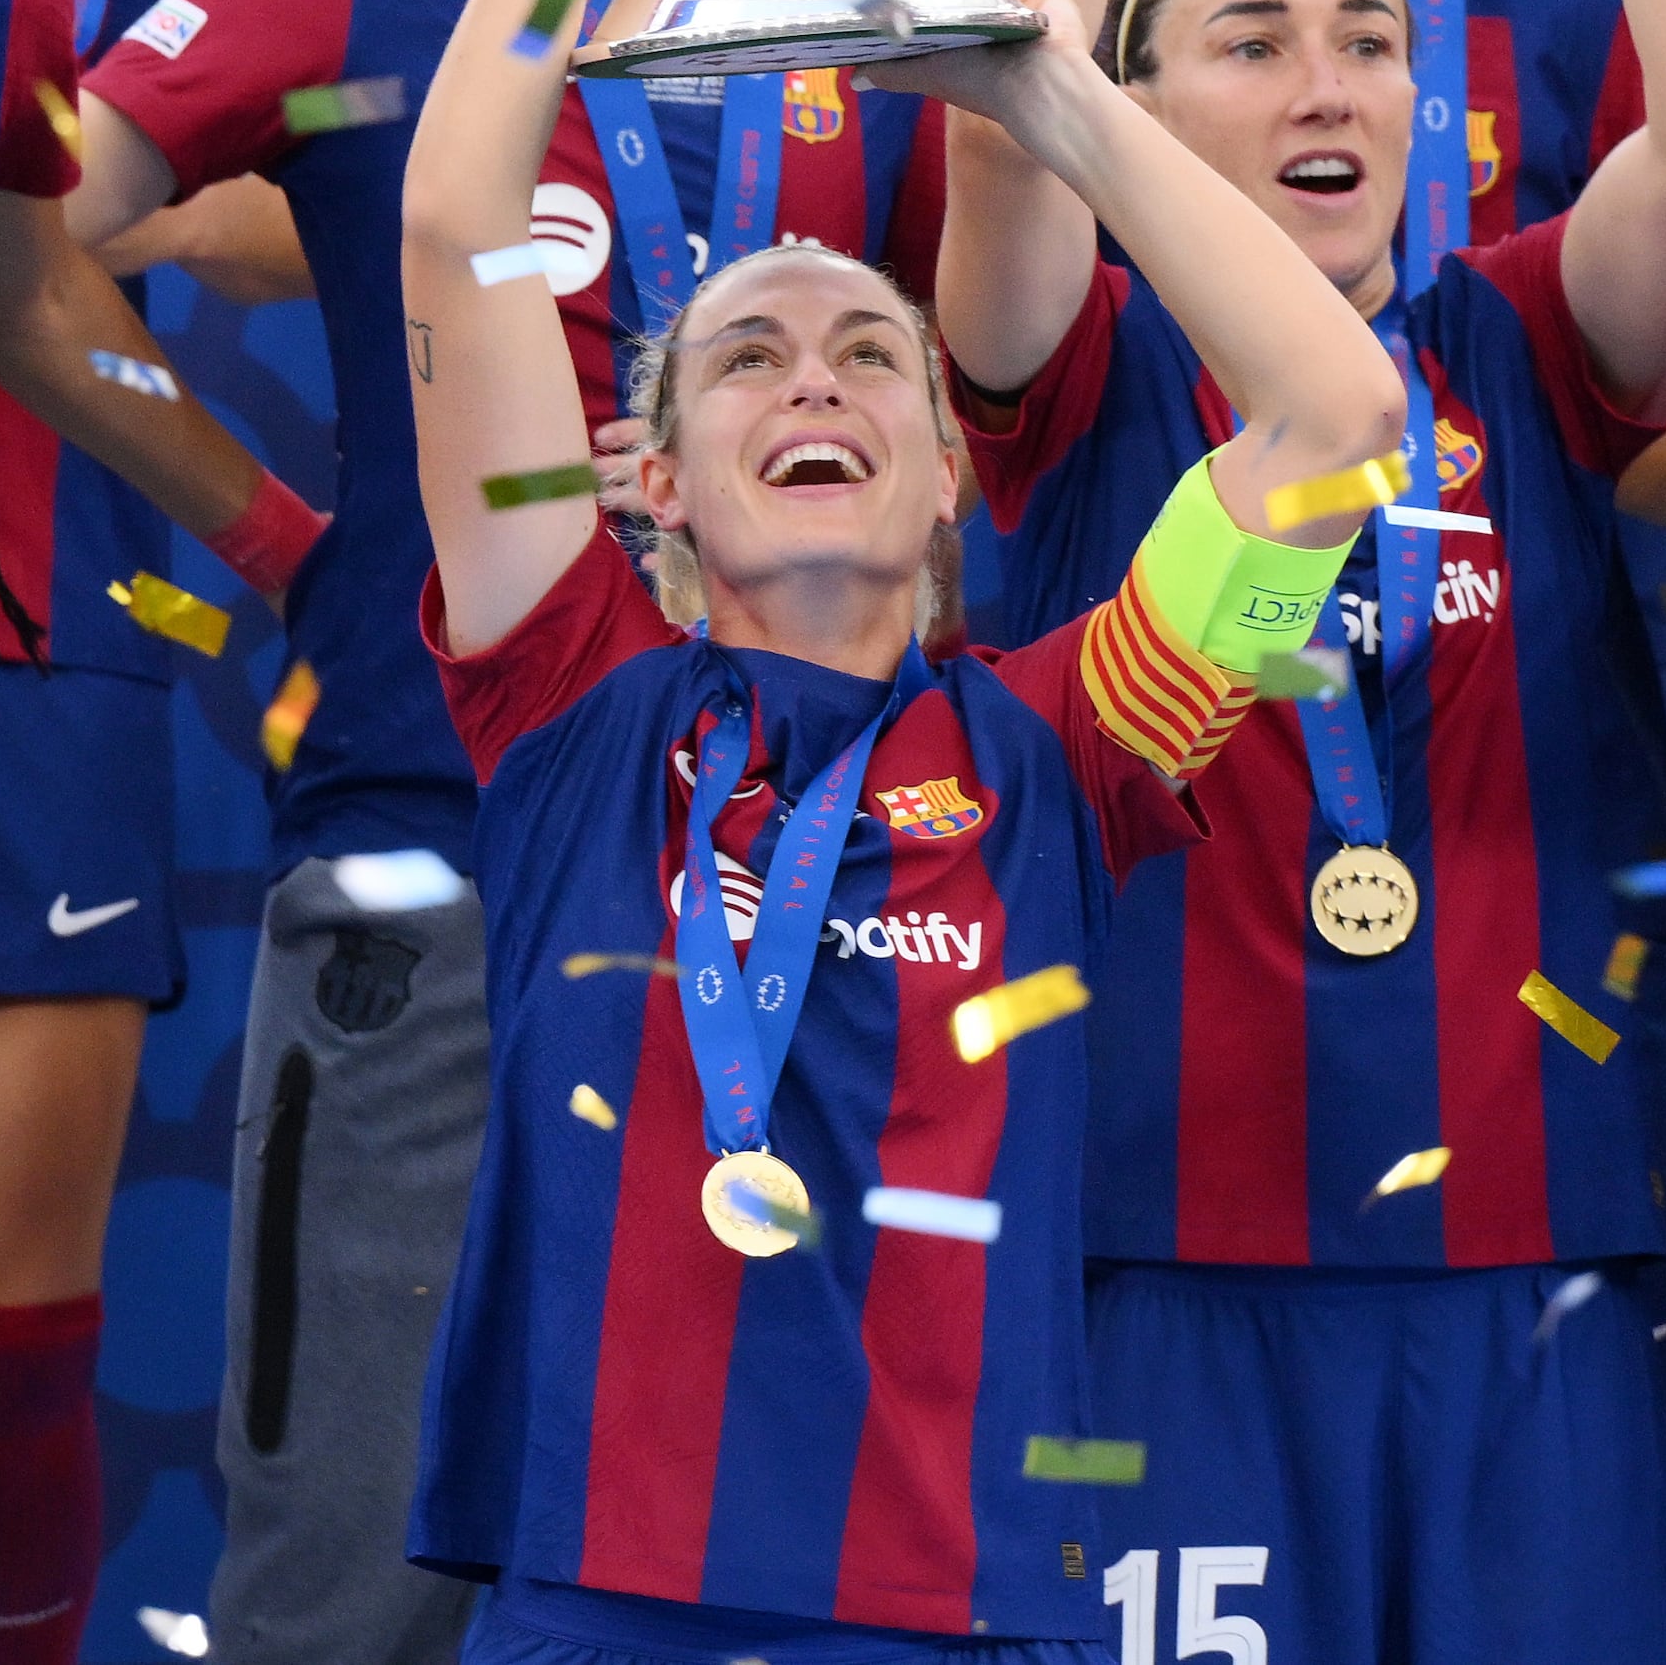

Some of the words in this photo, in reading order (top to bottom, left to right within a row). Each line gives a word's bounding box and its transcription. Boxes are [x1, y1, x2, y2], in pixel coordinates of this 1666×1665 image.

[1400, 527, 1419, 604] FINA
[816, 791, 841, 814] 24
[915, 806, 950, 821] FCB
[784, 817, 829, 912] FINAL
[722, 1058, 758, 1143] INAL
[1103, 1545, 1270, 1665] 15
